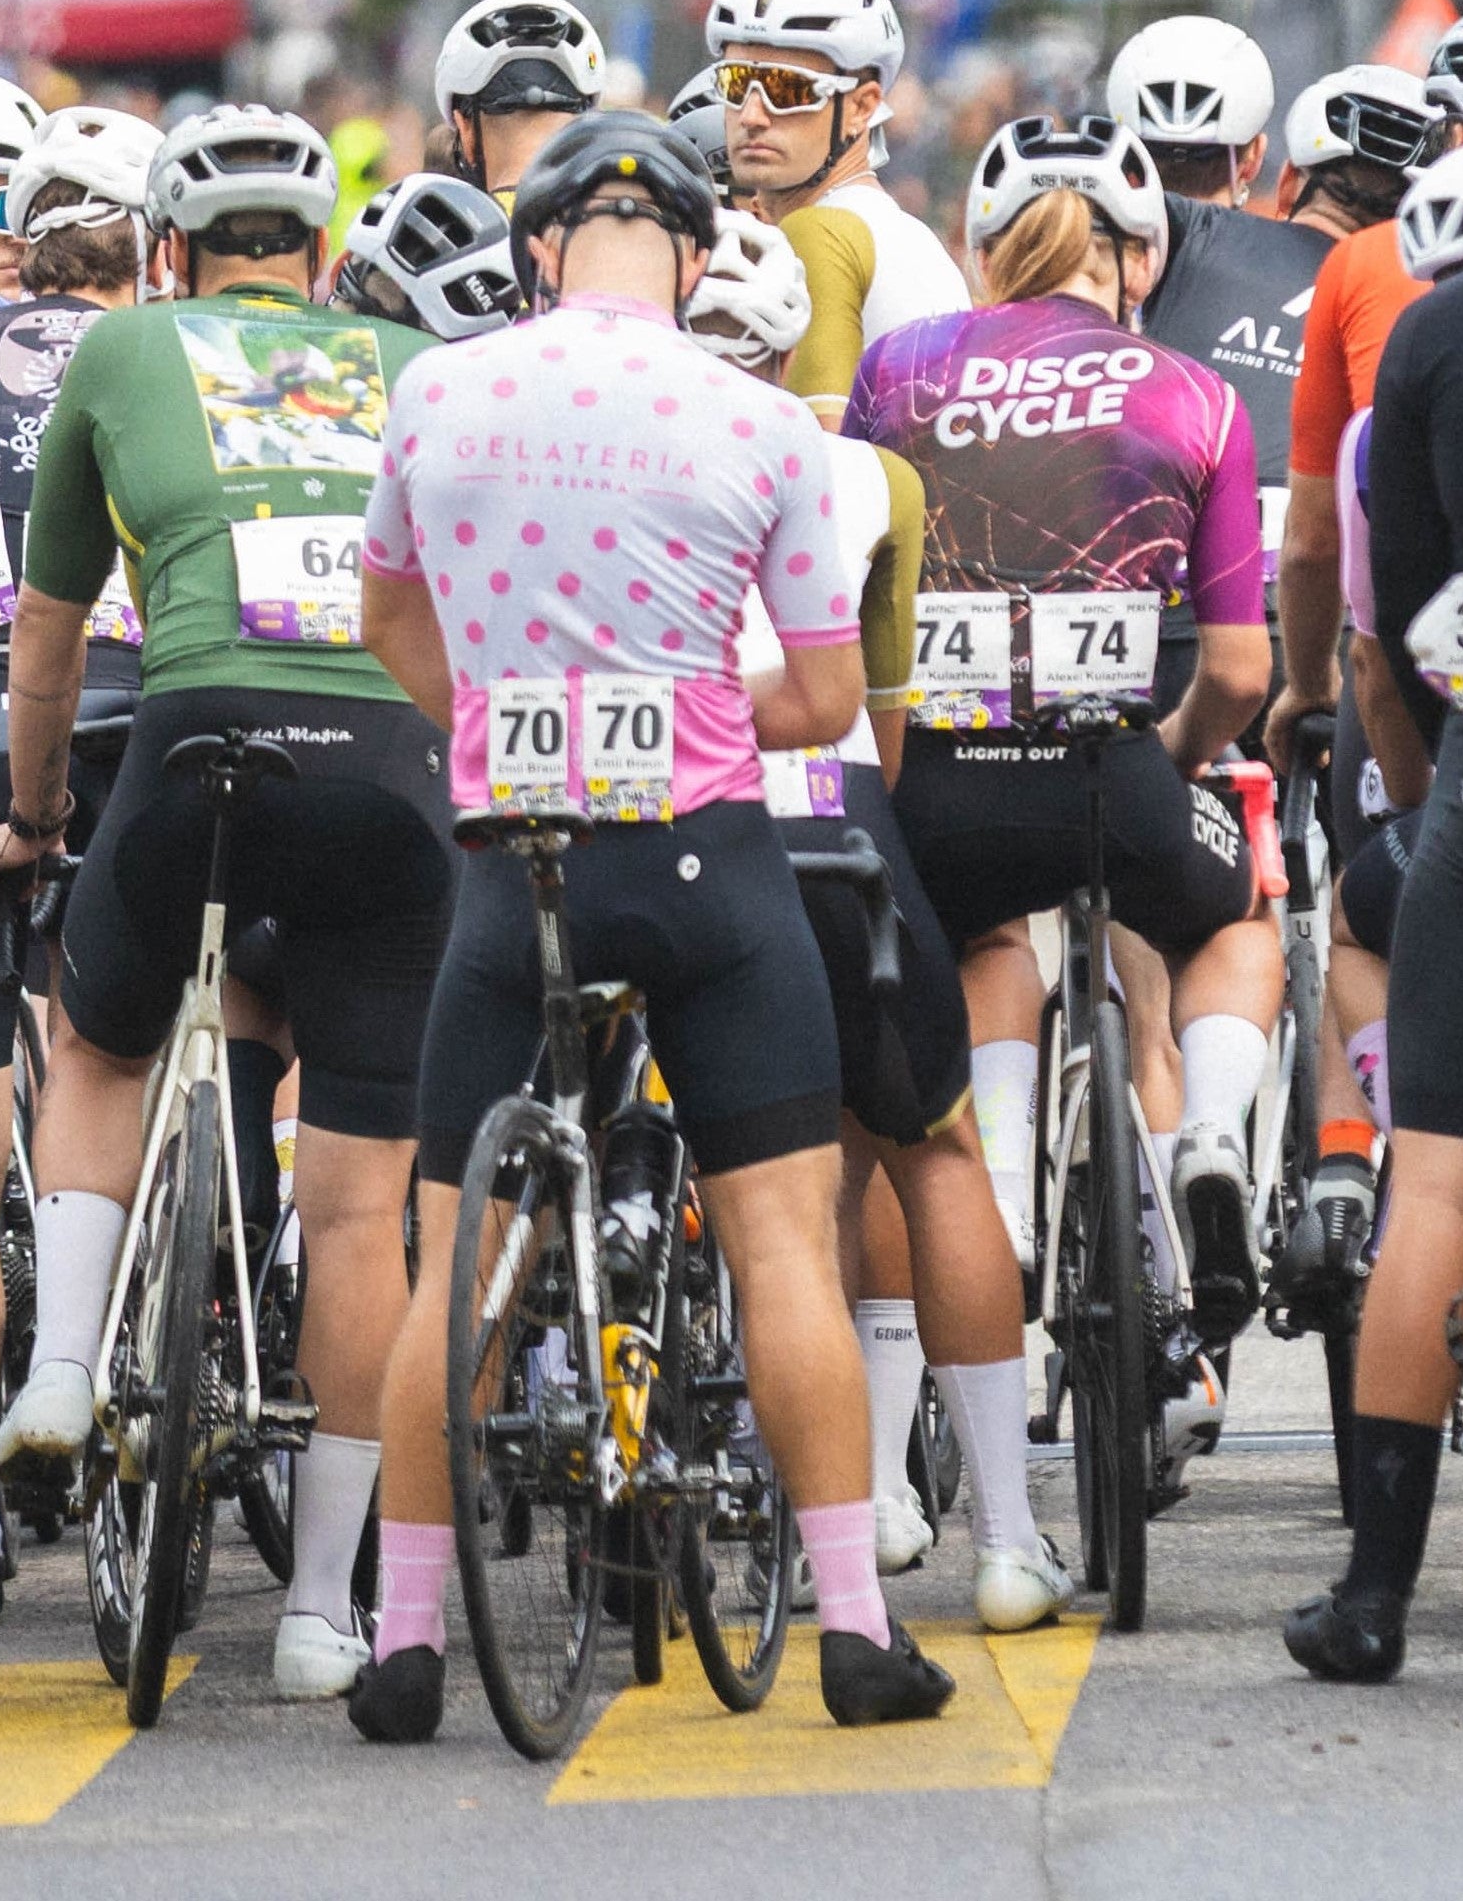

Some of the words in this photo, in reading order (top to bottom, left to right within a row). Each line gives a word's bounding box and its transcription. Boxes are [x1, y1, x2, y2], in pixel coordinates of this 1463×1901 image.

[466, 274, 493, 312] KASK
[958, 347, 1156, 399] DISCO
[1211, 347, 1264, 369] RACING
[934, 382, 1130, 449] CYCLE
[455, 436, 696, 481] GELATERIA
[552, 475, 628, 494] BERNA
[302, 537, 362, 579] 64
[916, 620, 975, 665] 74
[1069, 619, 1130, 665] 74
[499, 708, 564, 757] 70
[596, 703, 664, 752] 70
[955, 745, 1023, 762] LIGHTS
[1027, 745, 1068, 761] OUT
[1188, 783, 1237, 834] DISCO
[1191, 811, 1236, 868] CYCLE
[874, 1327, 916, 1343] GOBIK
